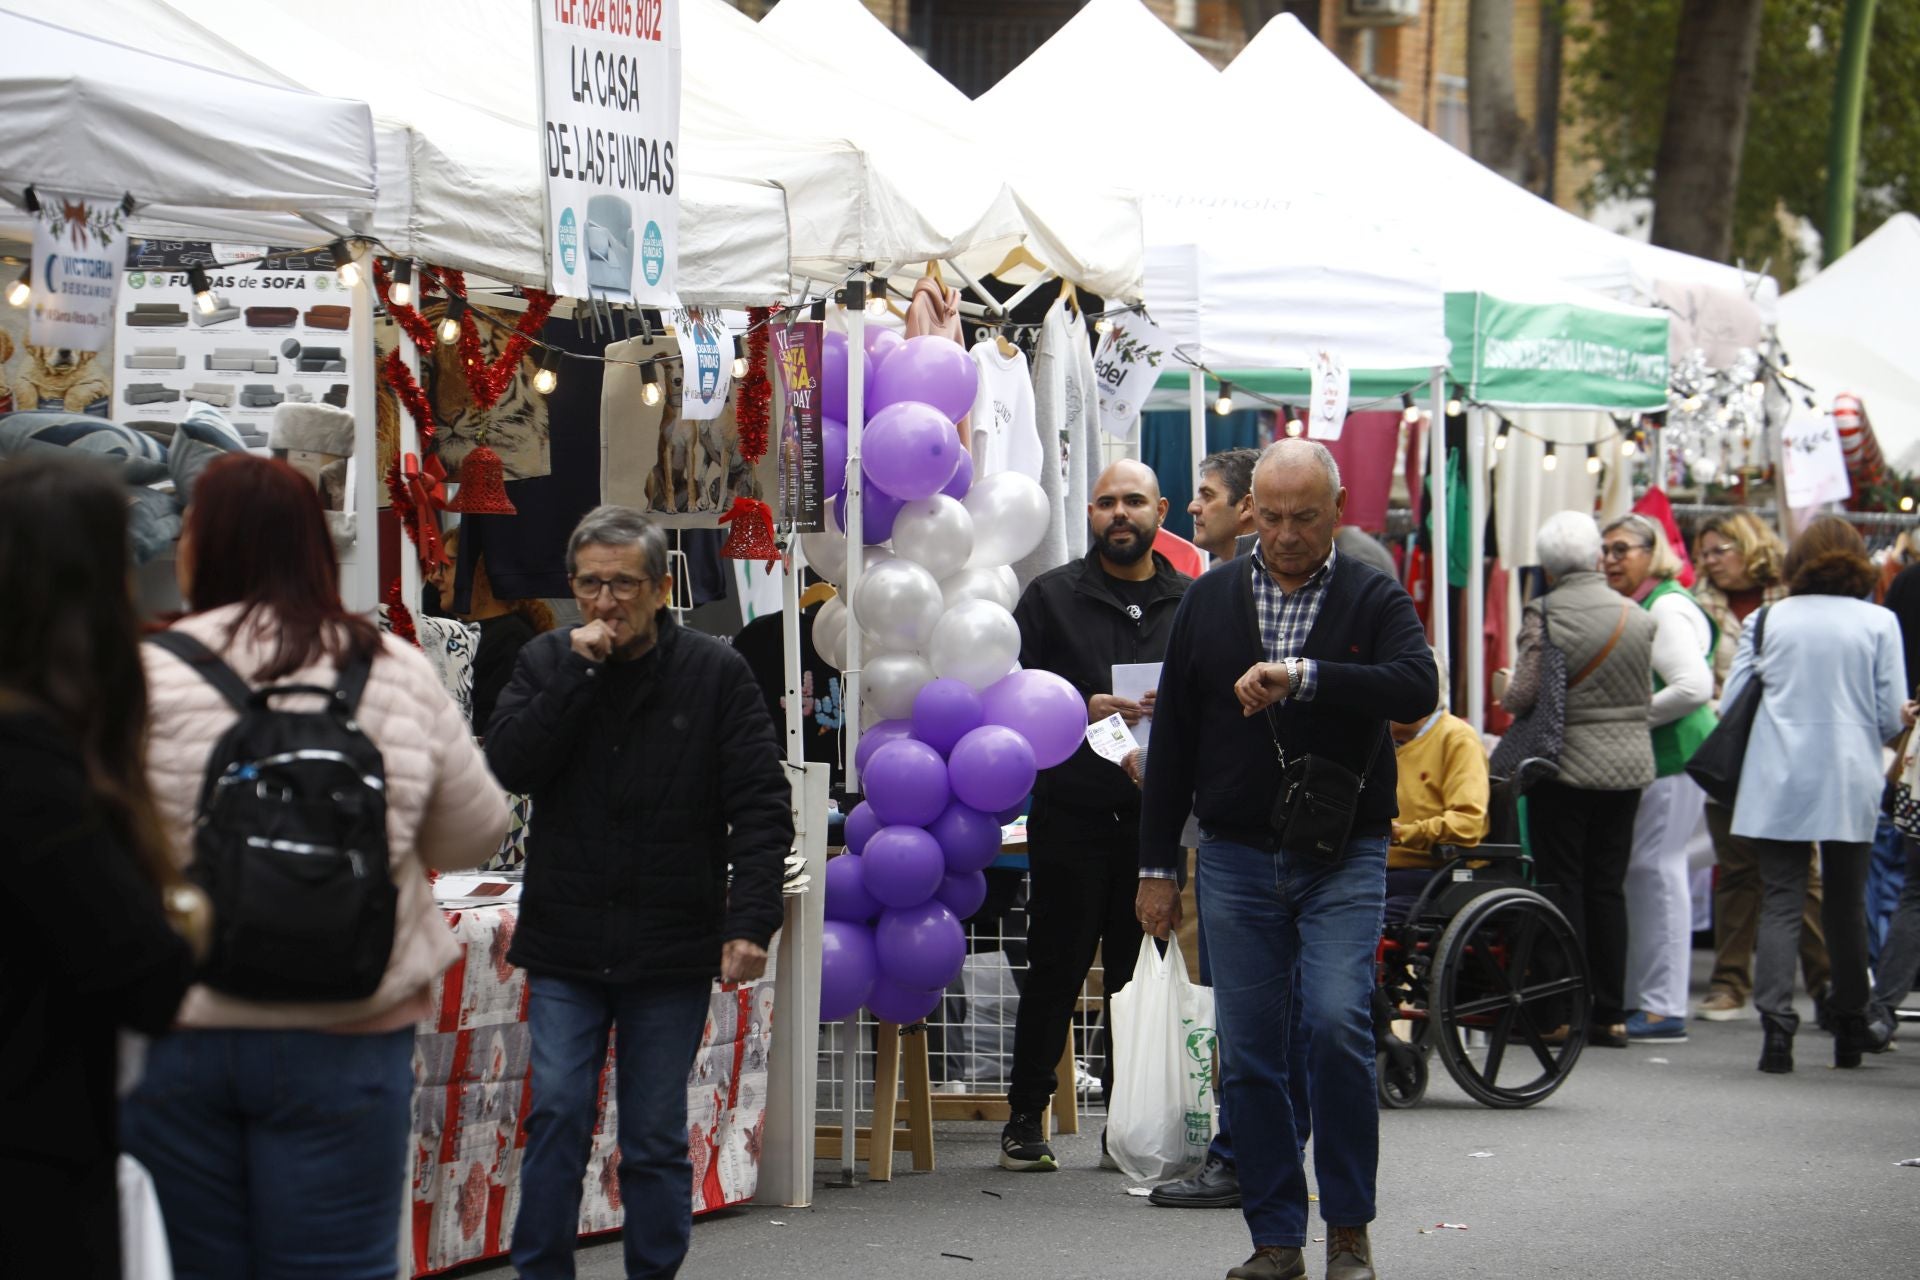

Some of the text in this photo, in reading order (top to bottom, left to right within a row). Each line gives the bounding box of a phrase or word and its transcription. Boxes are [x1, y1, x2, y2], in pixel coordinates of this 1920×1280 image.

[583, 0, 605, 31] 624
[609, 0, 632, 37] 605
[636, 0, 661, 41] 802
[571, 44, 640, 113] LA CASA
[547, 121, 675, 195] DE LAS FUNDAS
[643, 246, 663, 258] FUNDAS
[62, 256, 113, 280] VICTORIA
[169, 274, 306, 290] FUDAS de SOFÁ
[776, 328, 789, 351] VI
[975, 327, 1023, 343] ONY
[699, 354, 719, 368] FUNDAS
[793, 389, 812, 409] DAY
